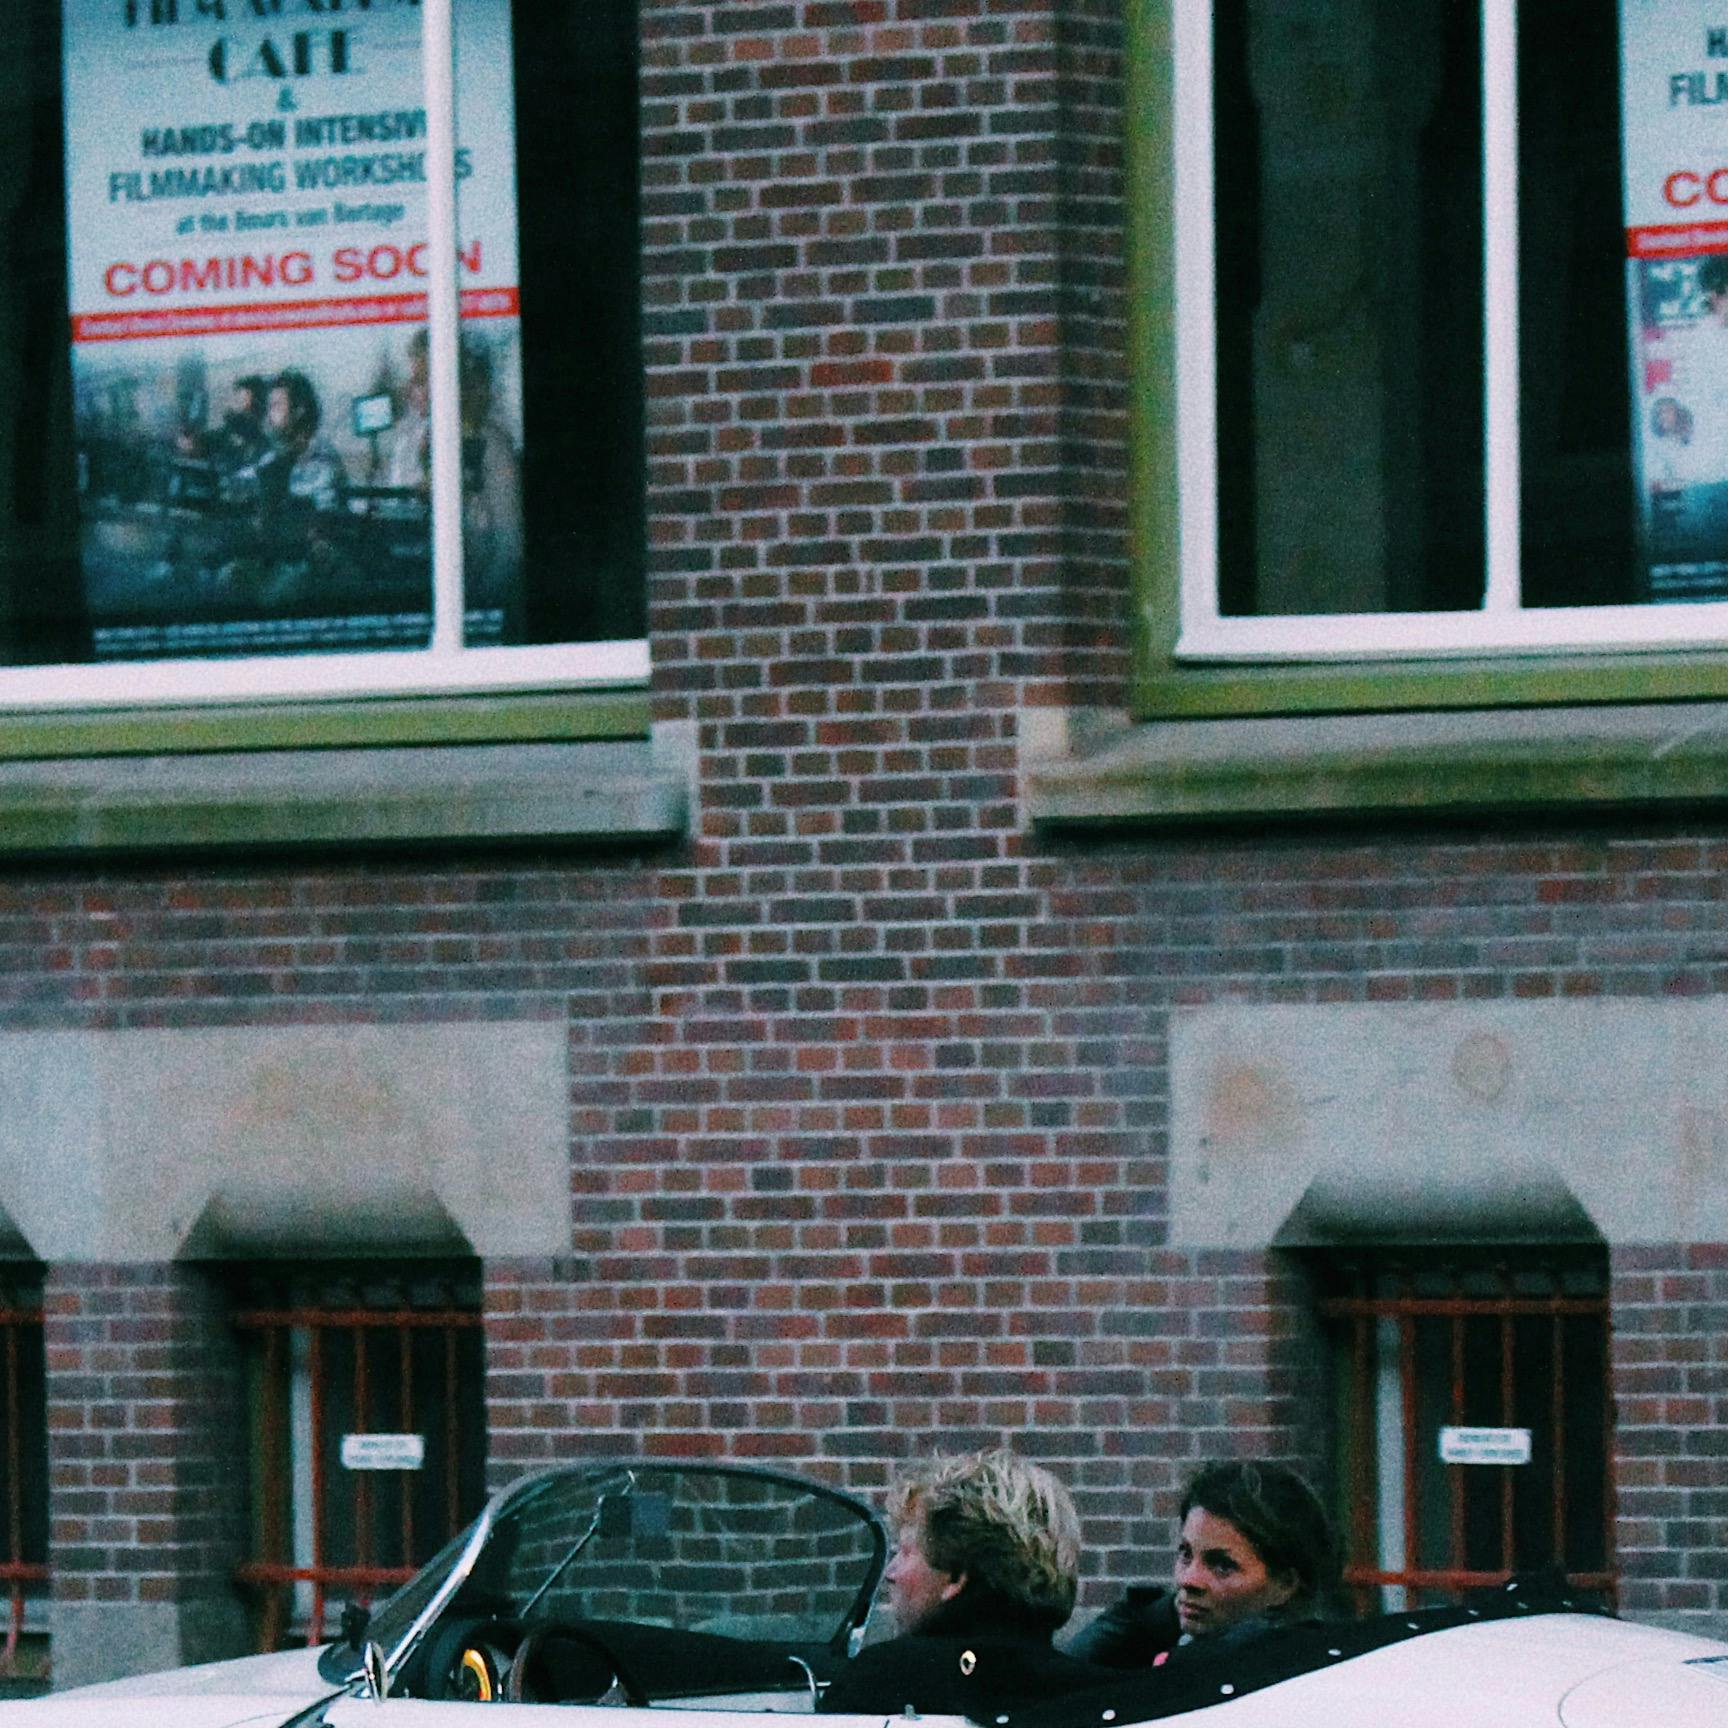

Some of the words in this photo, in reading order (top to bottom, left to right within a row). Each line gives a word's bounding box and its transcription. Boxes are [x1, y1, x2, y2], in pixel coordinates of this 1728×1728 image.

[141, 118, 287, 157] HANDS-ON
[294, 107, 427, 149] INTENSIV
[109, 158, 286, 204] FILMMAKING
[294, 147, 473, 191] WORKSHS
[105, 251, 314, 297] COMING
